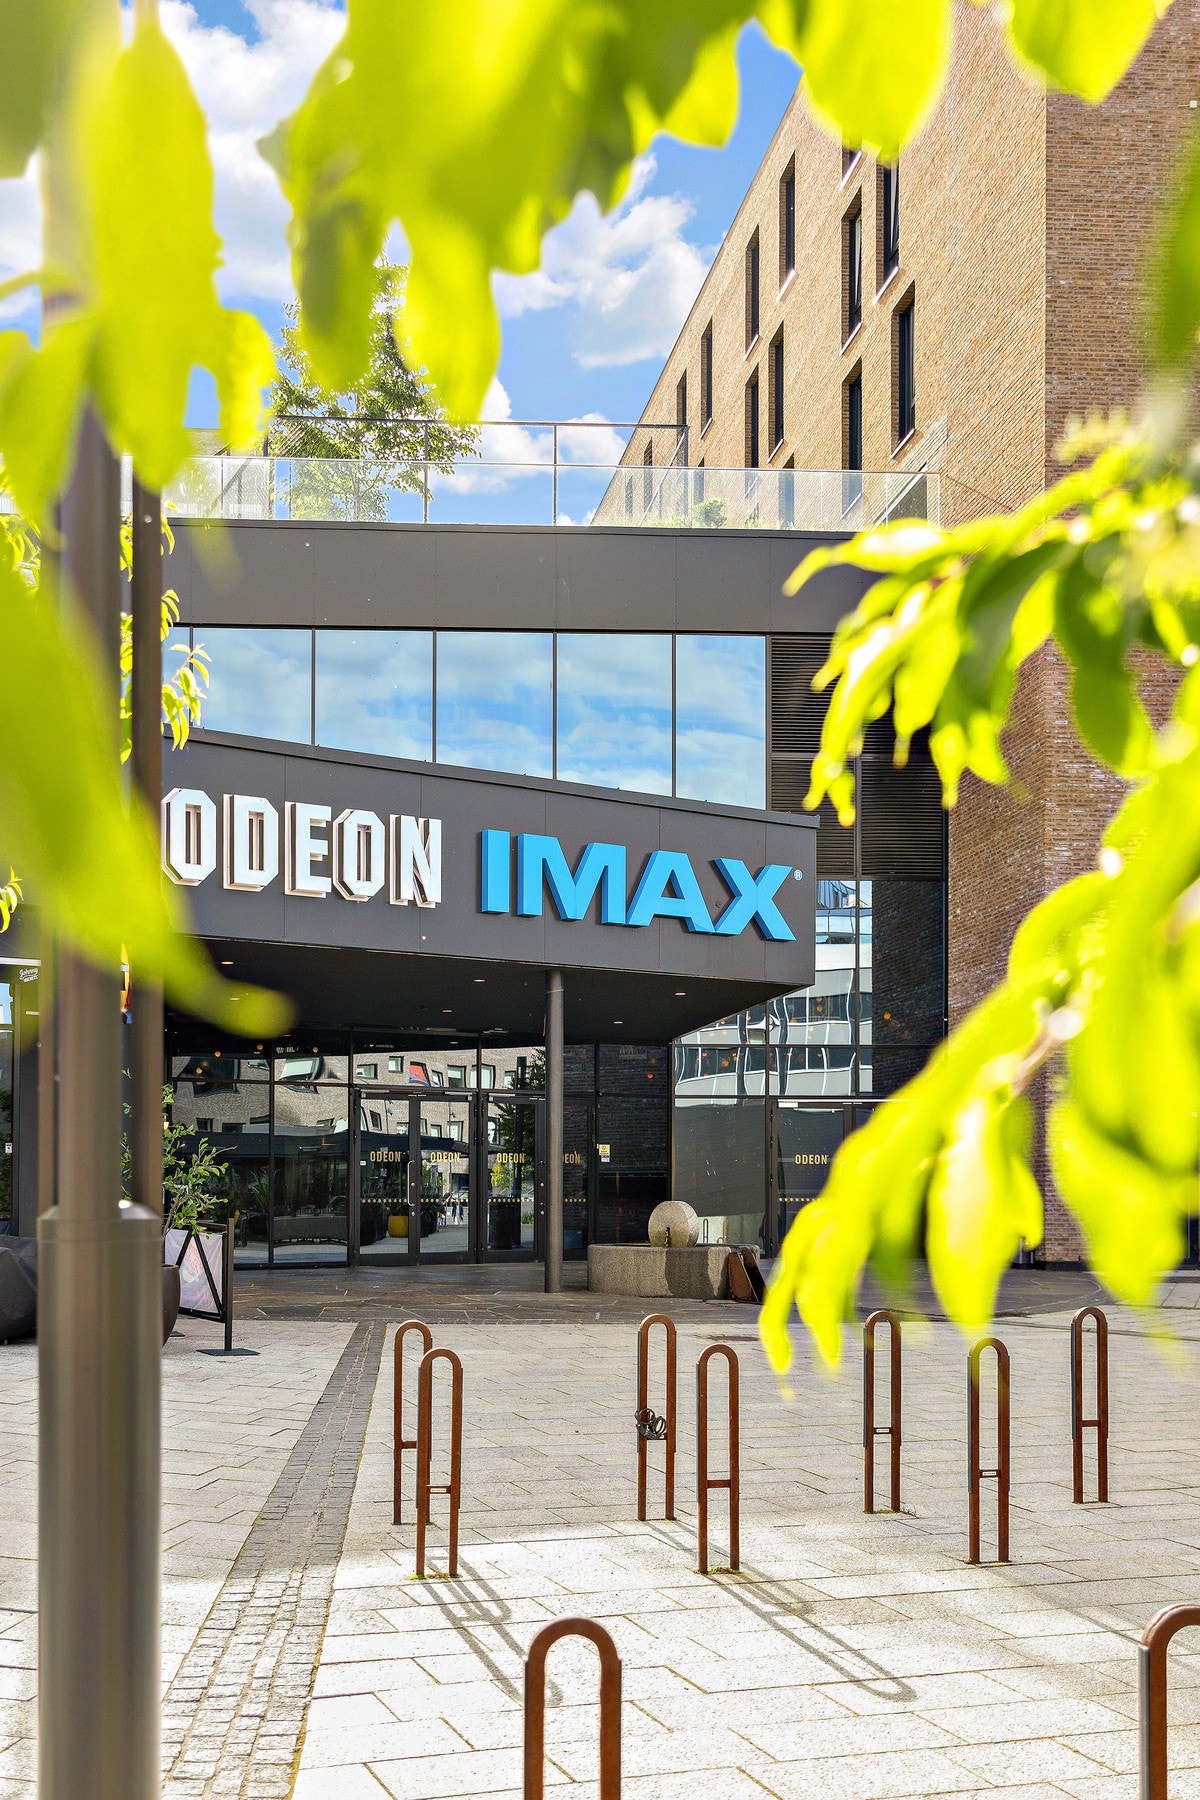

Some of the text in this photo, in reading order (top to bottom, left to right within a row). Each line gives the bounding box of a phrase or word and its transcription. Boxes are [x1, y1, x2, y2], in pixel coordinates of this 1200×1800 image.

[161, 787, 442, 908] ODEON
[369, 1151, 401, 1163] ODEON
[430, 1151, 461, 1163] ODEON
[496, 1152, 526, 1164] ODEON
[562, 1152, 581, 1164] EON
[794, 1154, 828, 1165] ODEON
